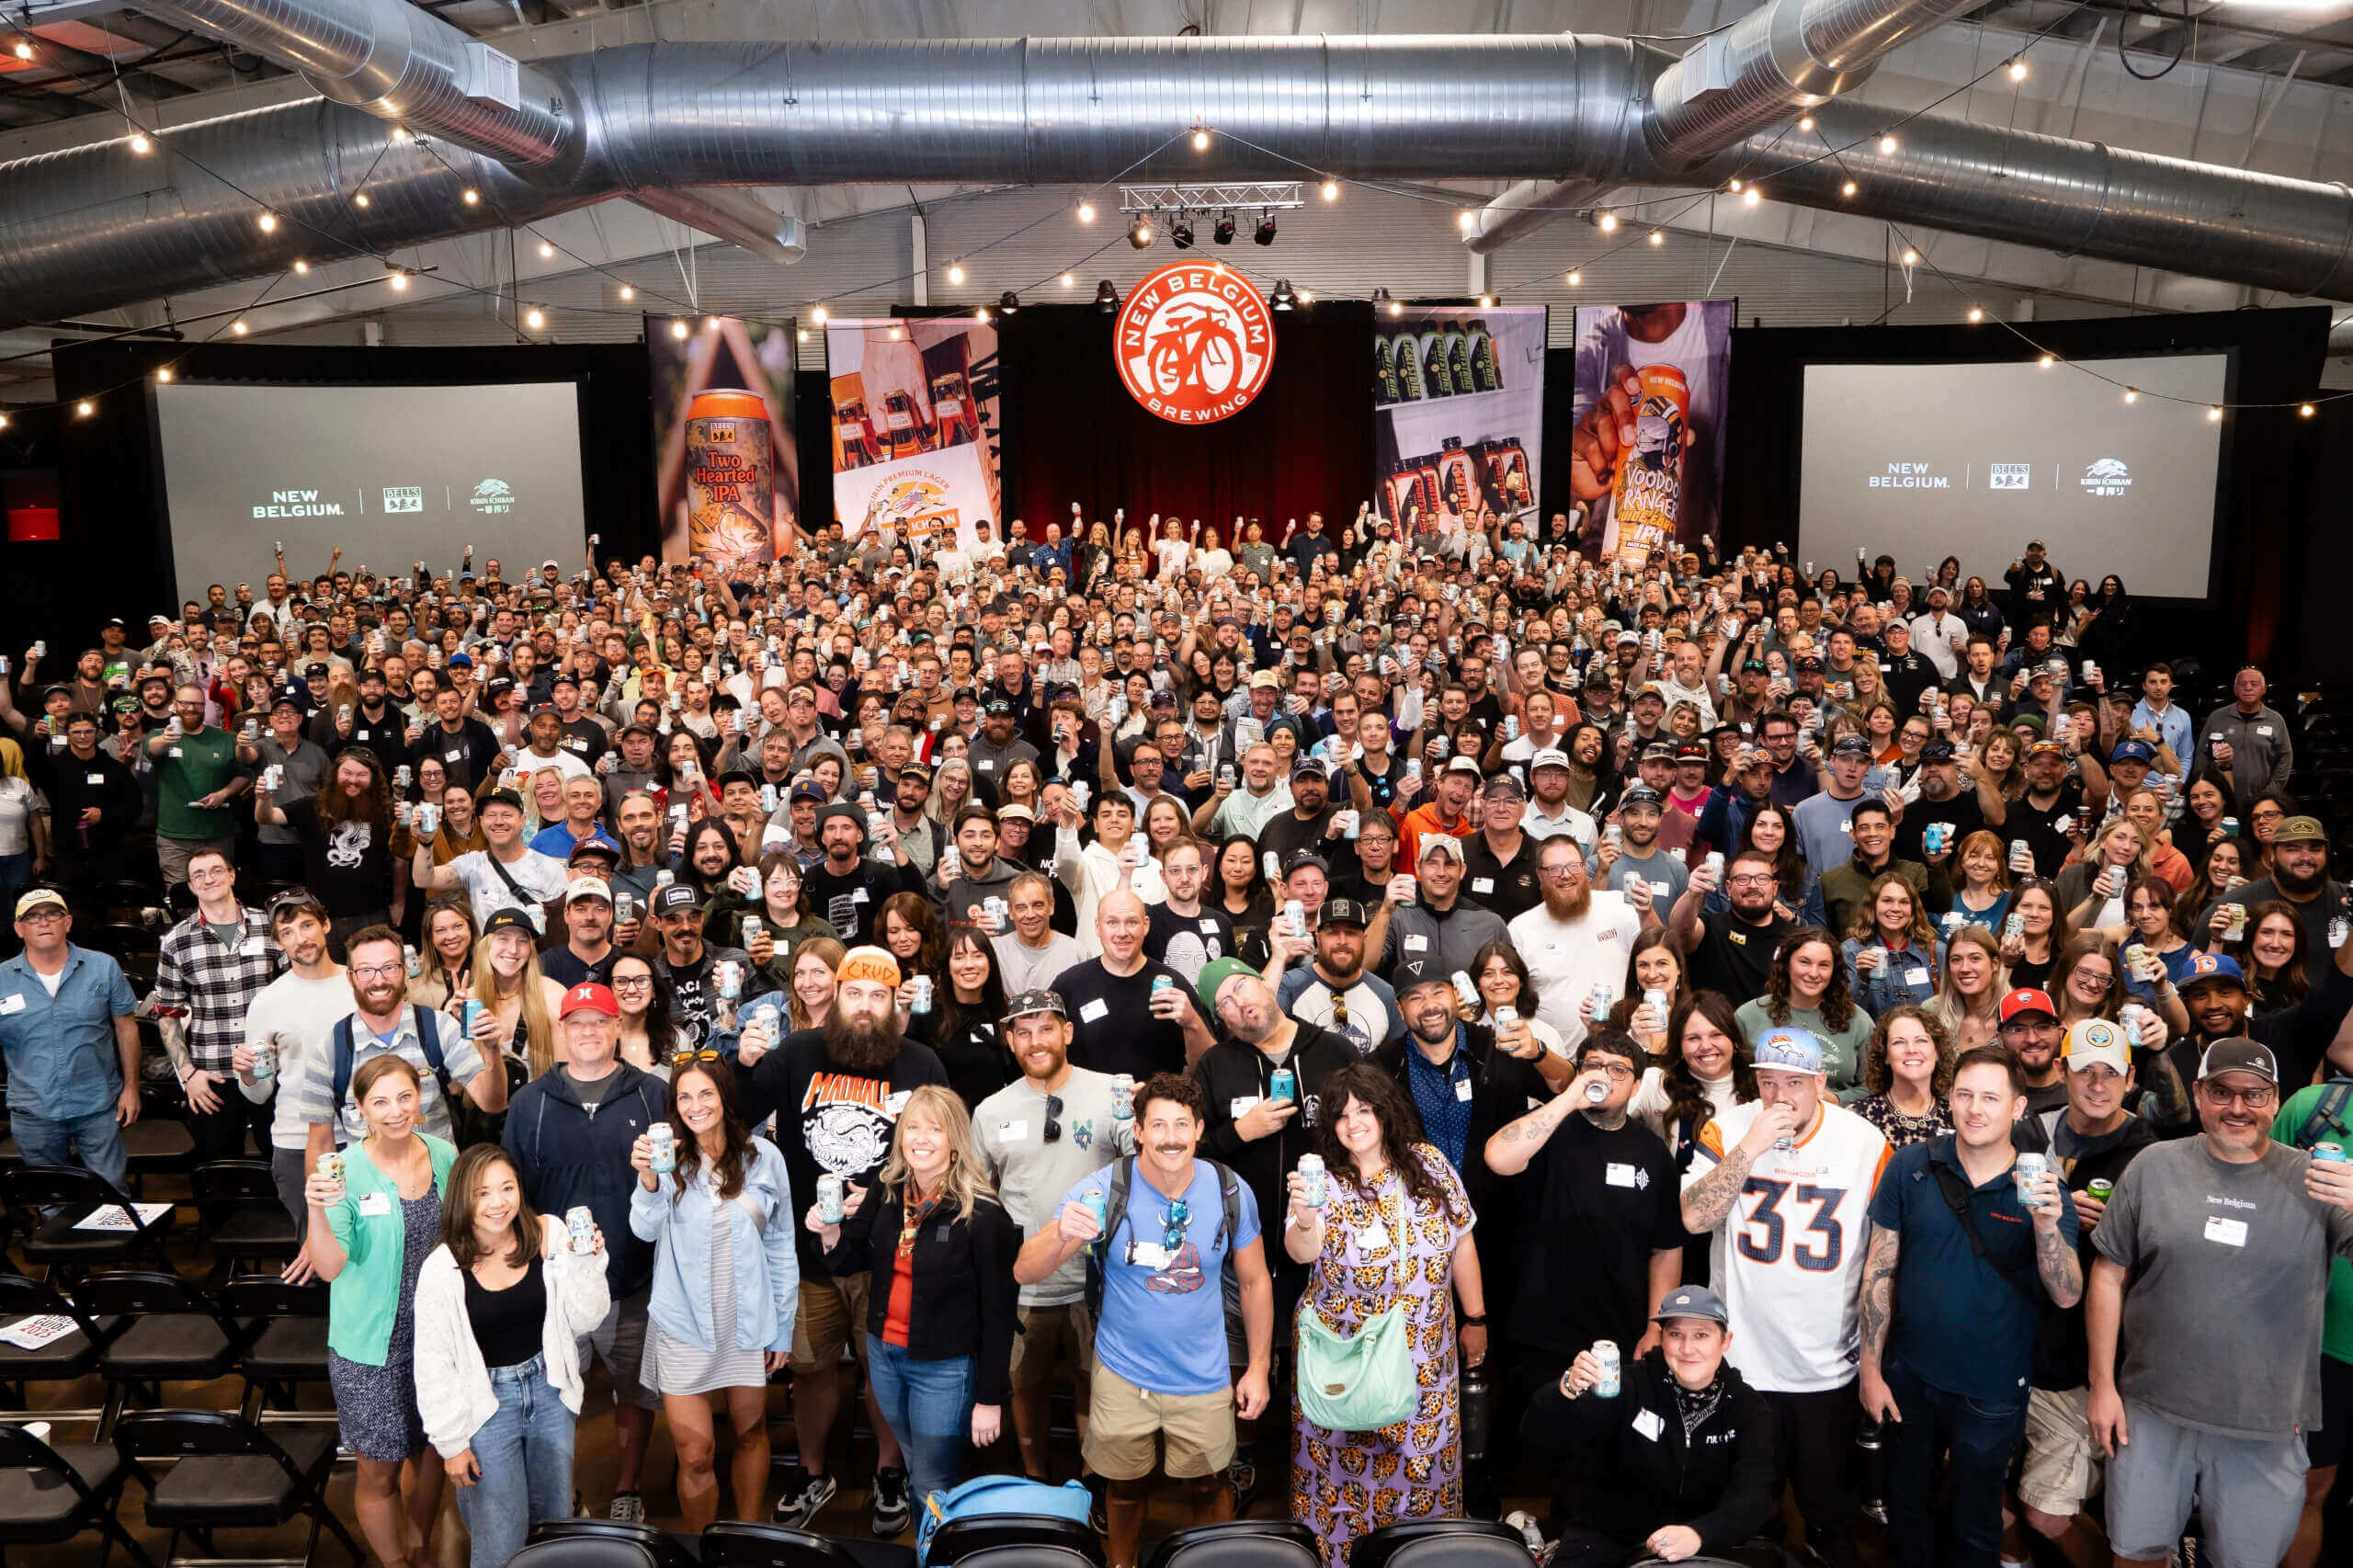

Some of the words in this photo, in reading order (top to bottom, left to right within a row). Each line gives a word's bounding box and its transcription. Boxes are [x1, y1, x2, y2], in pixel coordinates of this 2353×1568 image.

[1125, 290, 1160, 347] NEW
[1167, 273, 1266, 344] BELGIUM
[1147, 393, 1247, 421] BREWING
[707, 450, 742, 469] Two
[1887, 462, 1929, 474] NEW
[696, 465, 757, 483] Hearted
[883, 470, 922, 486] PREMIUM
[924, 471, 949, 489] LAGER
[1627, 467, 1679, 499] VOODOO
[272, 489, 319, 504] NEW
[713, 484, 741, 502] IPA
[1622, 488, 1677, 523] RANGER
[1633, 524, 1665, 547] IPA
[847, 961, 896, 981] CRUD
[801, 1071, 898, 1124] MADBALL
[1774, 1167, 1816, 1177] BRONCOS
[2206, 1194, 2222, 1205] New
[2222, 1198, 2256, 1210] Belgium
[1736, 1176, 1849, 1273] 33
[19, 1324, 57, 1338] 2025
[33, 1317, 70, 1332] GUIDE
